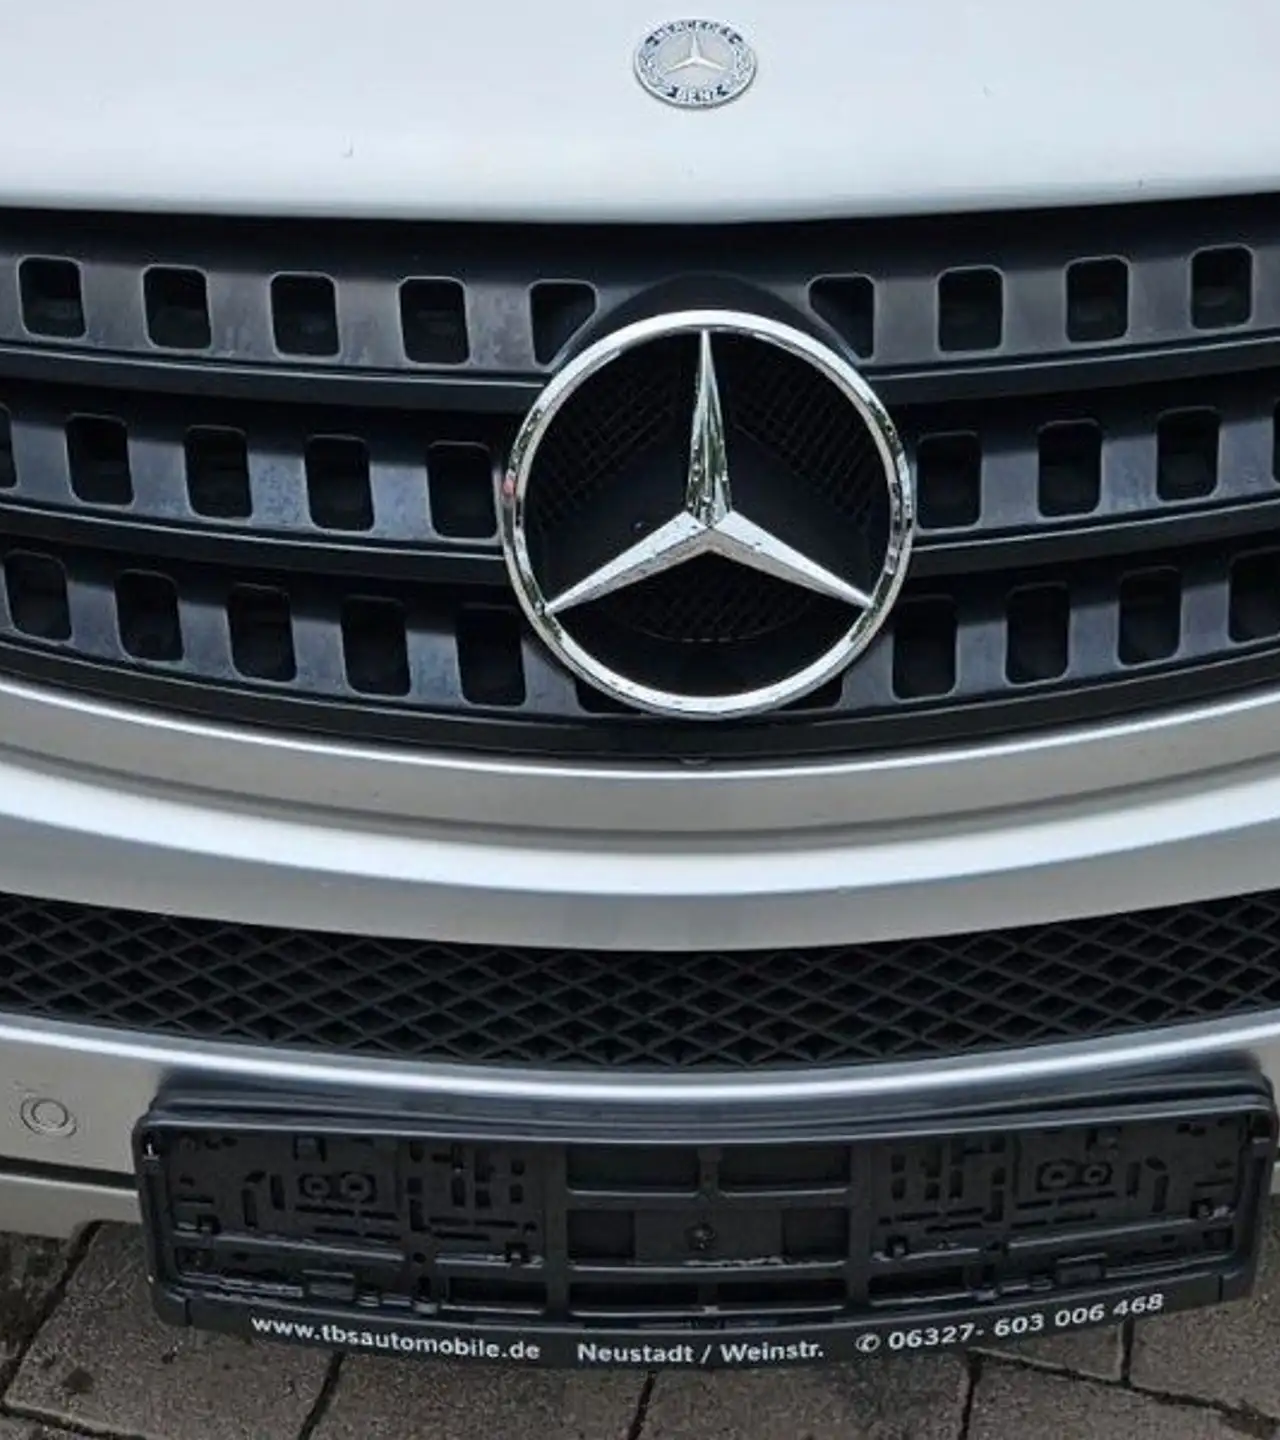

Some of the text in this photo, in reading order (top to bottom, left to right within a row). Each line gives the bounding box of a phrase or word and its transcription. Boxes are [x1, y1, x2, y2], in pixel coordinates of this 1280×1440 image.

[251, 1316, 541, 1360] www.tbsautomobile.de
[577, 1343, 694, 1362] Neustadt
[721, 1341, 824, 1362] Weinstr.
[994, 1314, 1045, 1337] 603
[1055, 1303, 1105, 1327] 006
[1113, 1293, 1164, 1316] 468
